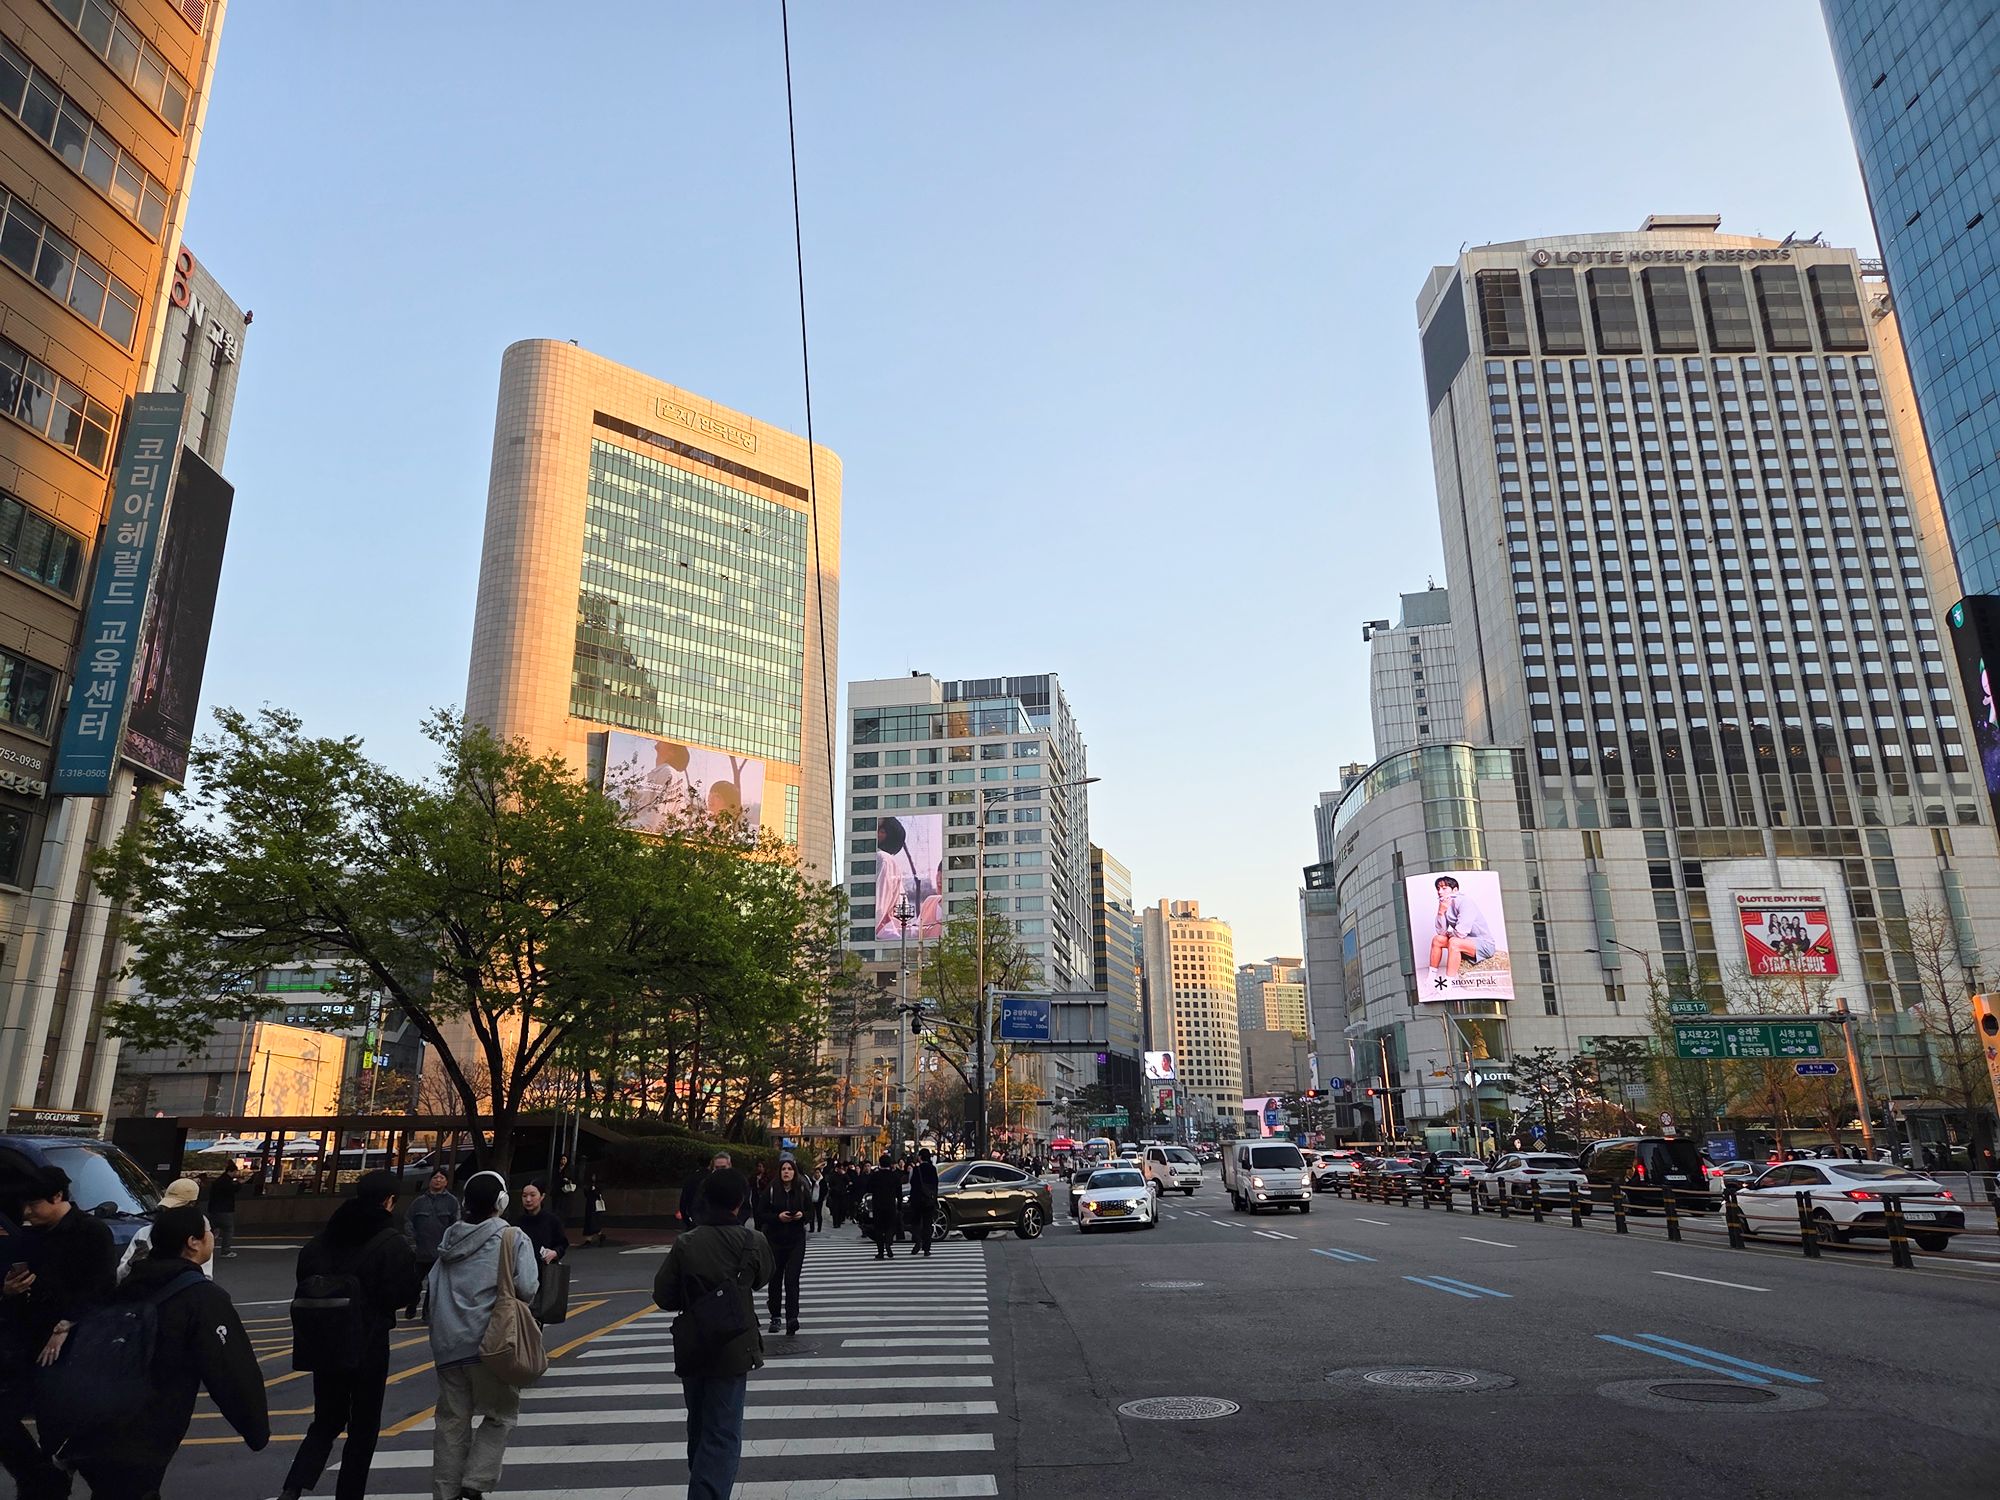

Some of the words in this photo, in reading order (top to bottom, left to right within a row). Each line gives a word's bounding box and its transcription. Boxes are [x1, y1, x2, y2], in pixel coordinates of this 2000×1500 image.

[1555, 251, 1624, 265] LOTTE
[1629, 250, 1695, 263] HOTELS
[1700, 251, 1710, 261] &
[1714, 249, 1792, 262] RESORTS
[103, 438, 164, 605] 코리아헤럴드
[78, 620, 127, 741] 교육센터
[1799, 895, 1822, 903] FREE
[1476, 976, 1497, 987] peak
[1672, 1003, 1707, 1012] 을지로1가
[1678, 1030, 1719, 1039] 을지로2가
[1737, 1027, 1761, 1036] 숭례문
[1780, 1029, 1796, 1038] 시청
[1741, 1047, 1770, 1056] 한국은행
[1483, 1072, 1513, 1081] LOTTE
